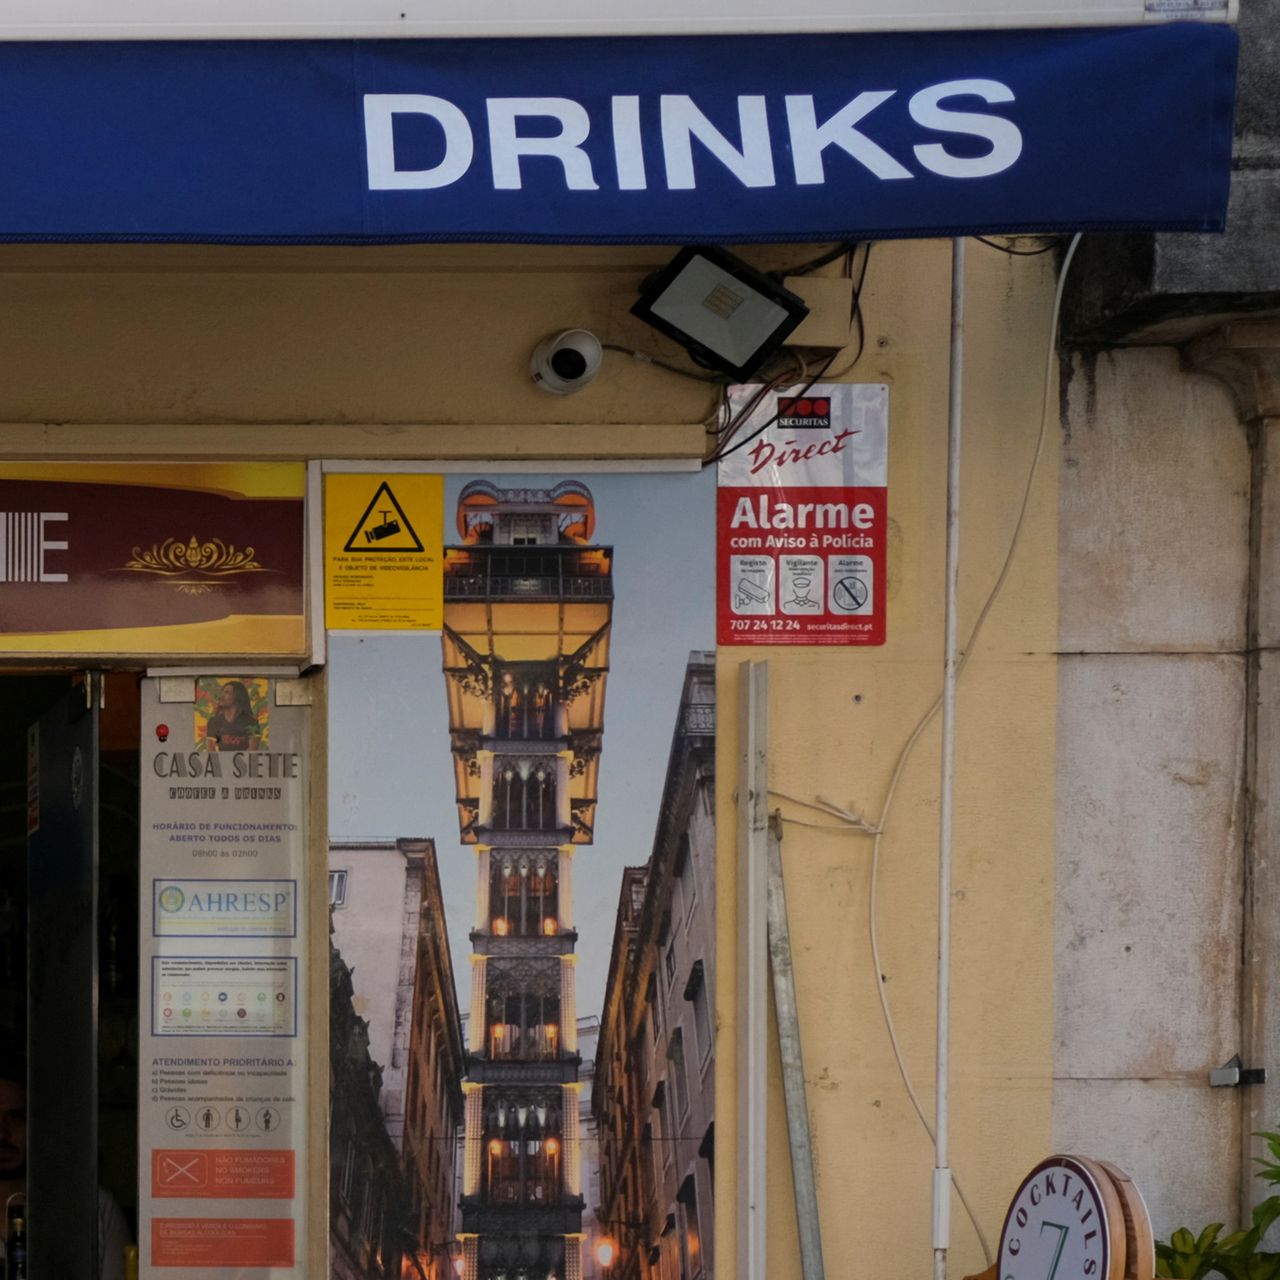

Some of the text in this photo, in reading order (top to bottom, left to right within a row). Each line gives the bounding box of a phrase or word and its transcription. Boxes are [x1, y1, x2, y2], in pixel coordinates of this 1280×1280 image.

[364, 79, 1022, 190] DRINKS
[778, 417, 829, 427] SECURITAS
[748, 427, 862, 475] Direct
[730, 494, 874, 529] Alarme
[731, 533, 873, 548] com Aviso Polícia
[786, 559, 818, 569] Vigilante
[730, 620, 751, 630] 707
[753, 620, 768, 630] 24
[771, 620, 783, 630] 12
[785, 620, 801, 630] 24
[153, 752, 298, 778] CASA SETE
[152, 822, 298, 831] HORÁRIO FUNCIONAMENTO:
[169, 835, 281, 843] ABERTO TODOS DIAS
[189, 892, 286, 913] AHRESP
[152, 1056, 282, 1067] ATENDIMENTO PRIORITÁRIO
[1008, 1172, 1097, 1276] COCKTAILS
